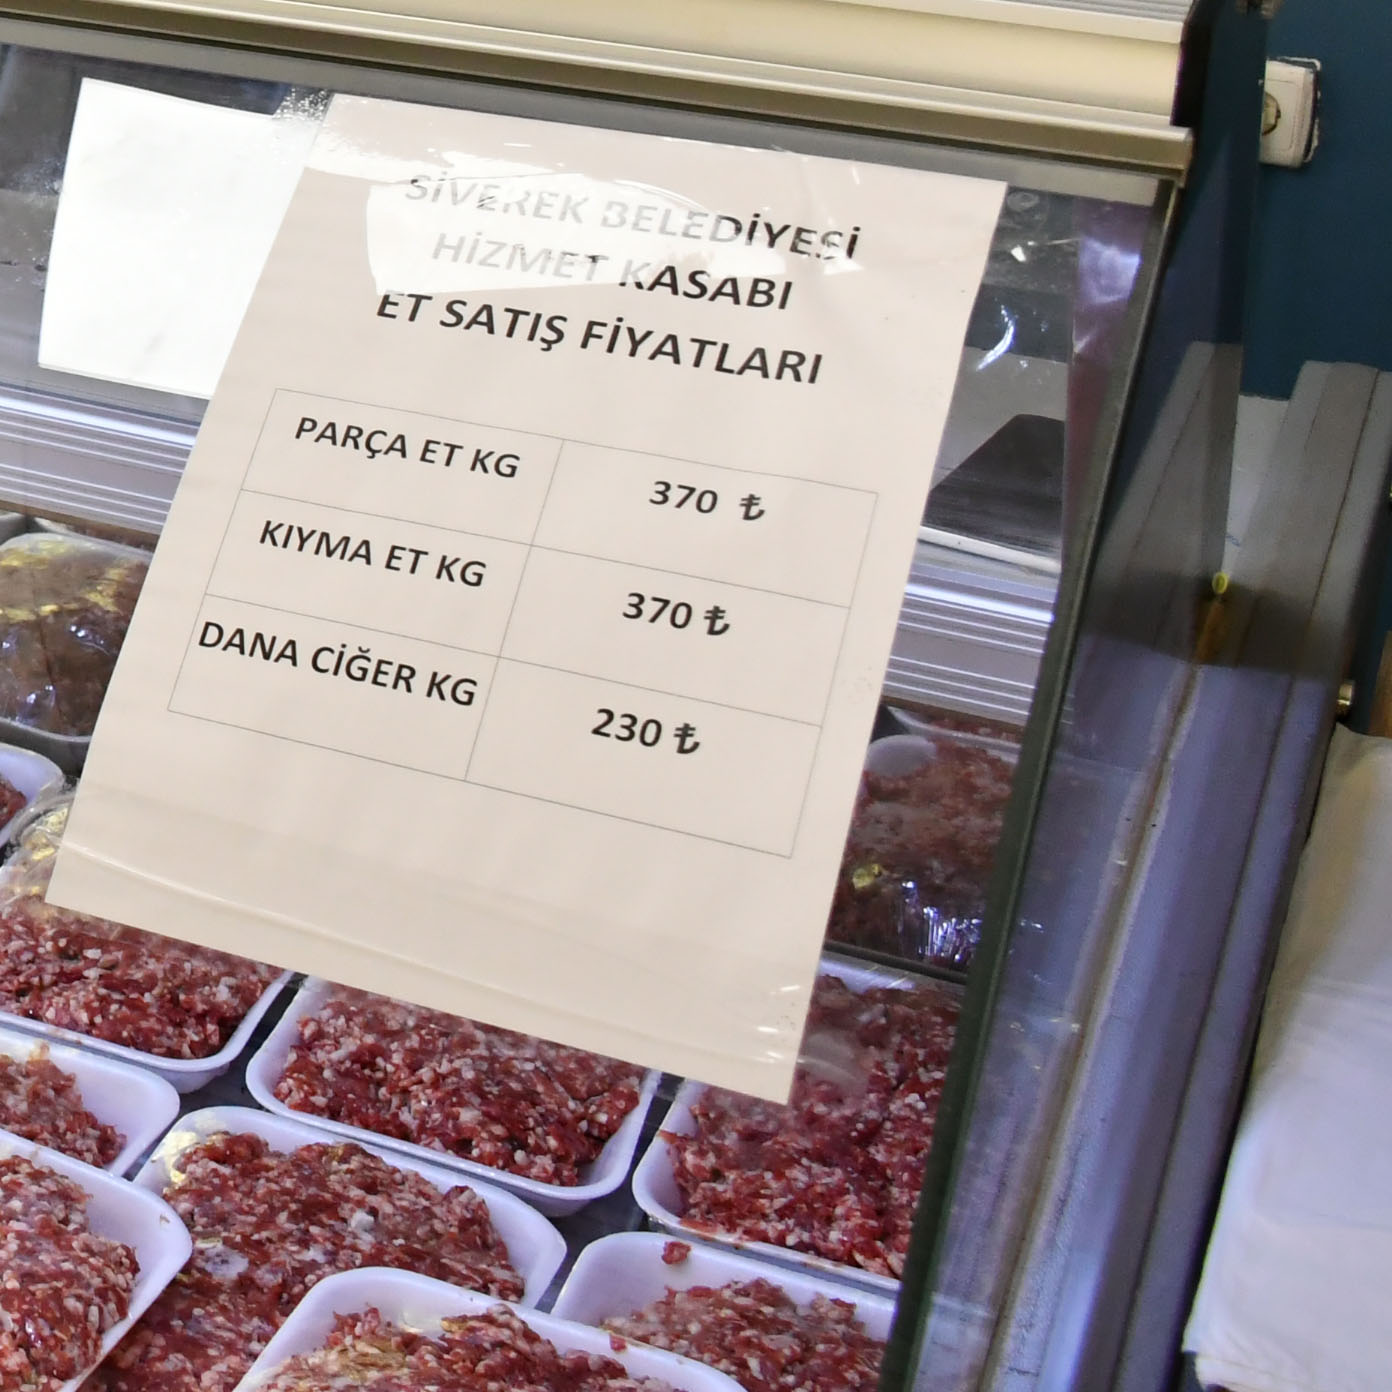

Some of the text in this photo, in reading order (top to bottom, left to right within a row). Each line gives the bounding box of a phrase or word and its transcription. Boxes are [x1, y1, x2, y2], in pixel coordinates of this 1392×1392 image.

[405, 170, 861, 260] SİVEREK BELEDİYESİ
[432, 231, 793, 310] HİZMET KASABI
[376, 292, 823, 384] ET SATIŞ FİYATLARI
[295, 416, 407, 461] PARÇA
[419, 438, 464, 468] ET
[469, 448, 521, 478] KG
[648, 480, 718, 515] 370
[259, 519, 372, 567] KIYMA
[384, 544, 429, 576] ET
[435, 554, 487, 588] KG
[622, 592, 693, 630] 370
[198, 619, 299, 669] DANA
[311, 642, 418, 695] CİĞER
[425, 671, 478, 708] KG
[591, 708, 663, 748] 230
